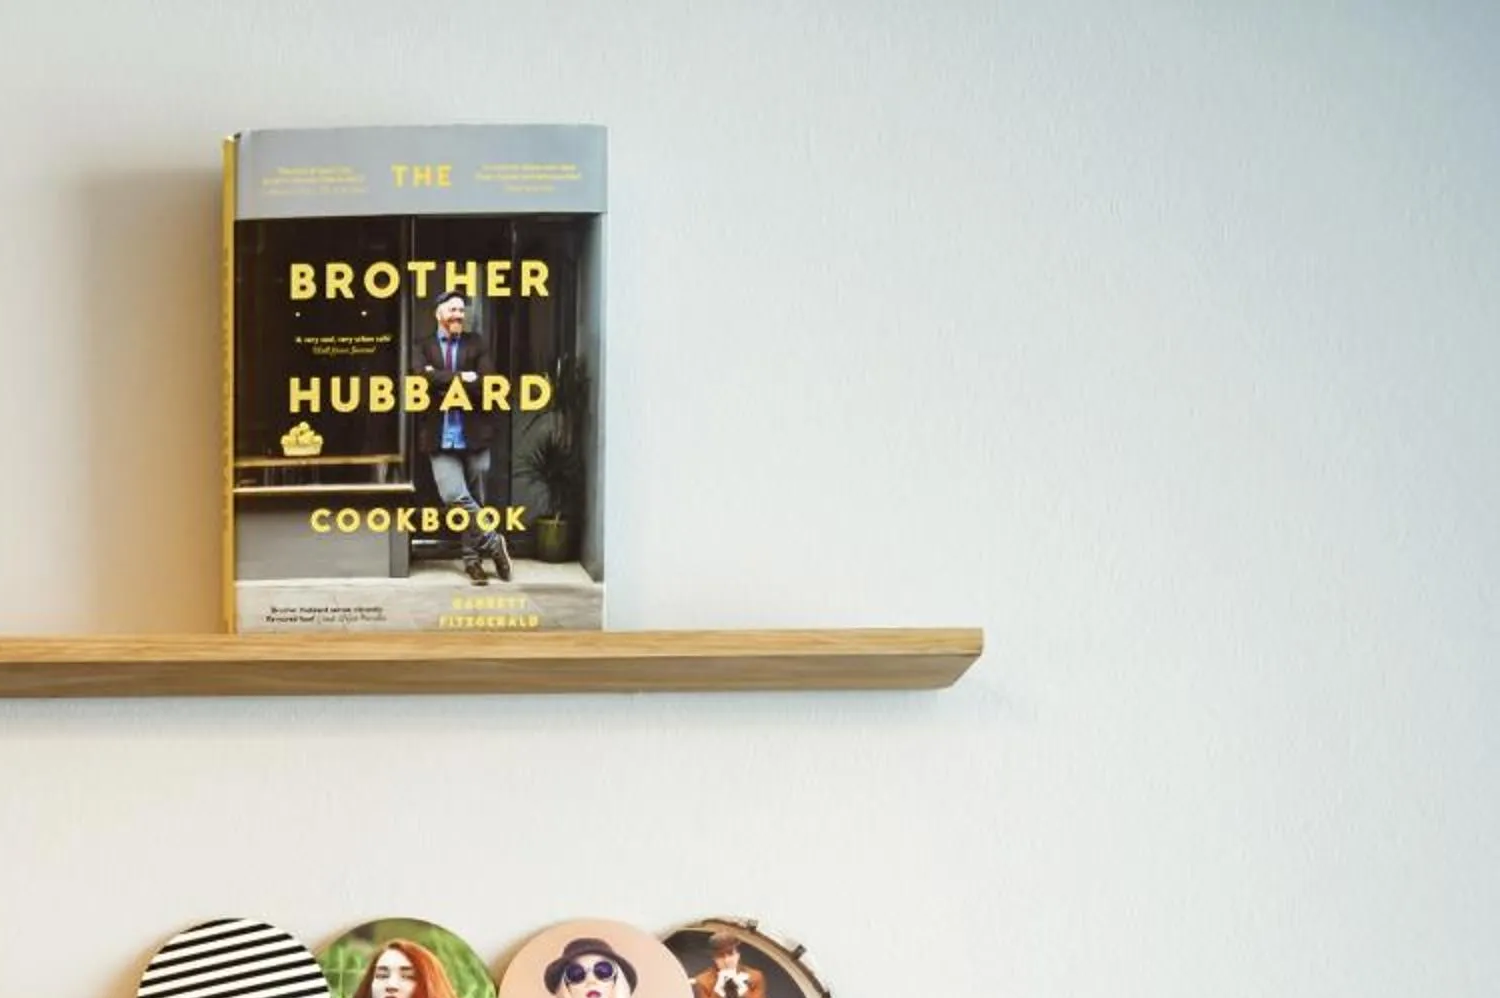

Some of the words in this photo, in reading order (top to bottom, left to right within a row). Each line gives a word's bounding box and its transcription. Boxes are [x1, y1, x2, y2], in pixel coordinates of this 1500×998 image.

[391, 165, 453, 187] THE
[290, 261, 550, 300] BROTHER
[289, 374, 553, 414] HUBBARD
[310, 506, 528, 534] COOKBOOK
